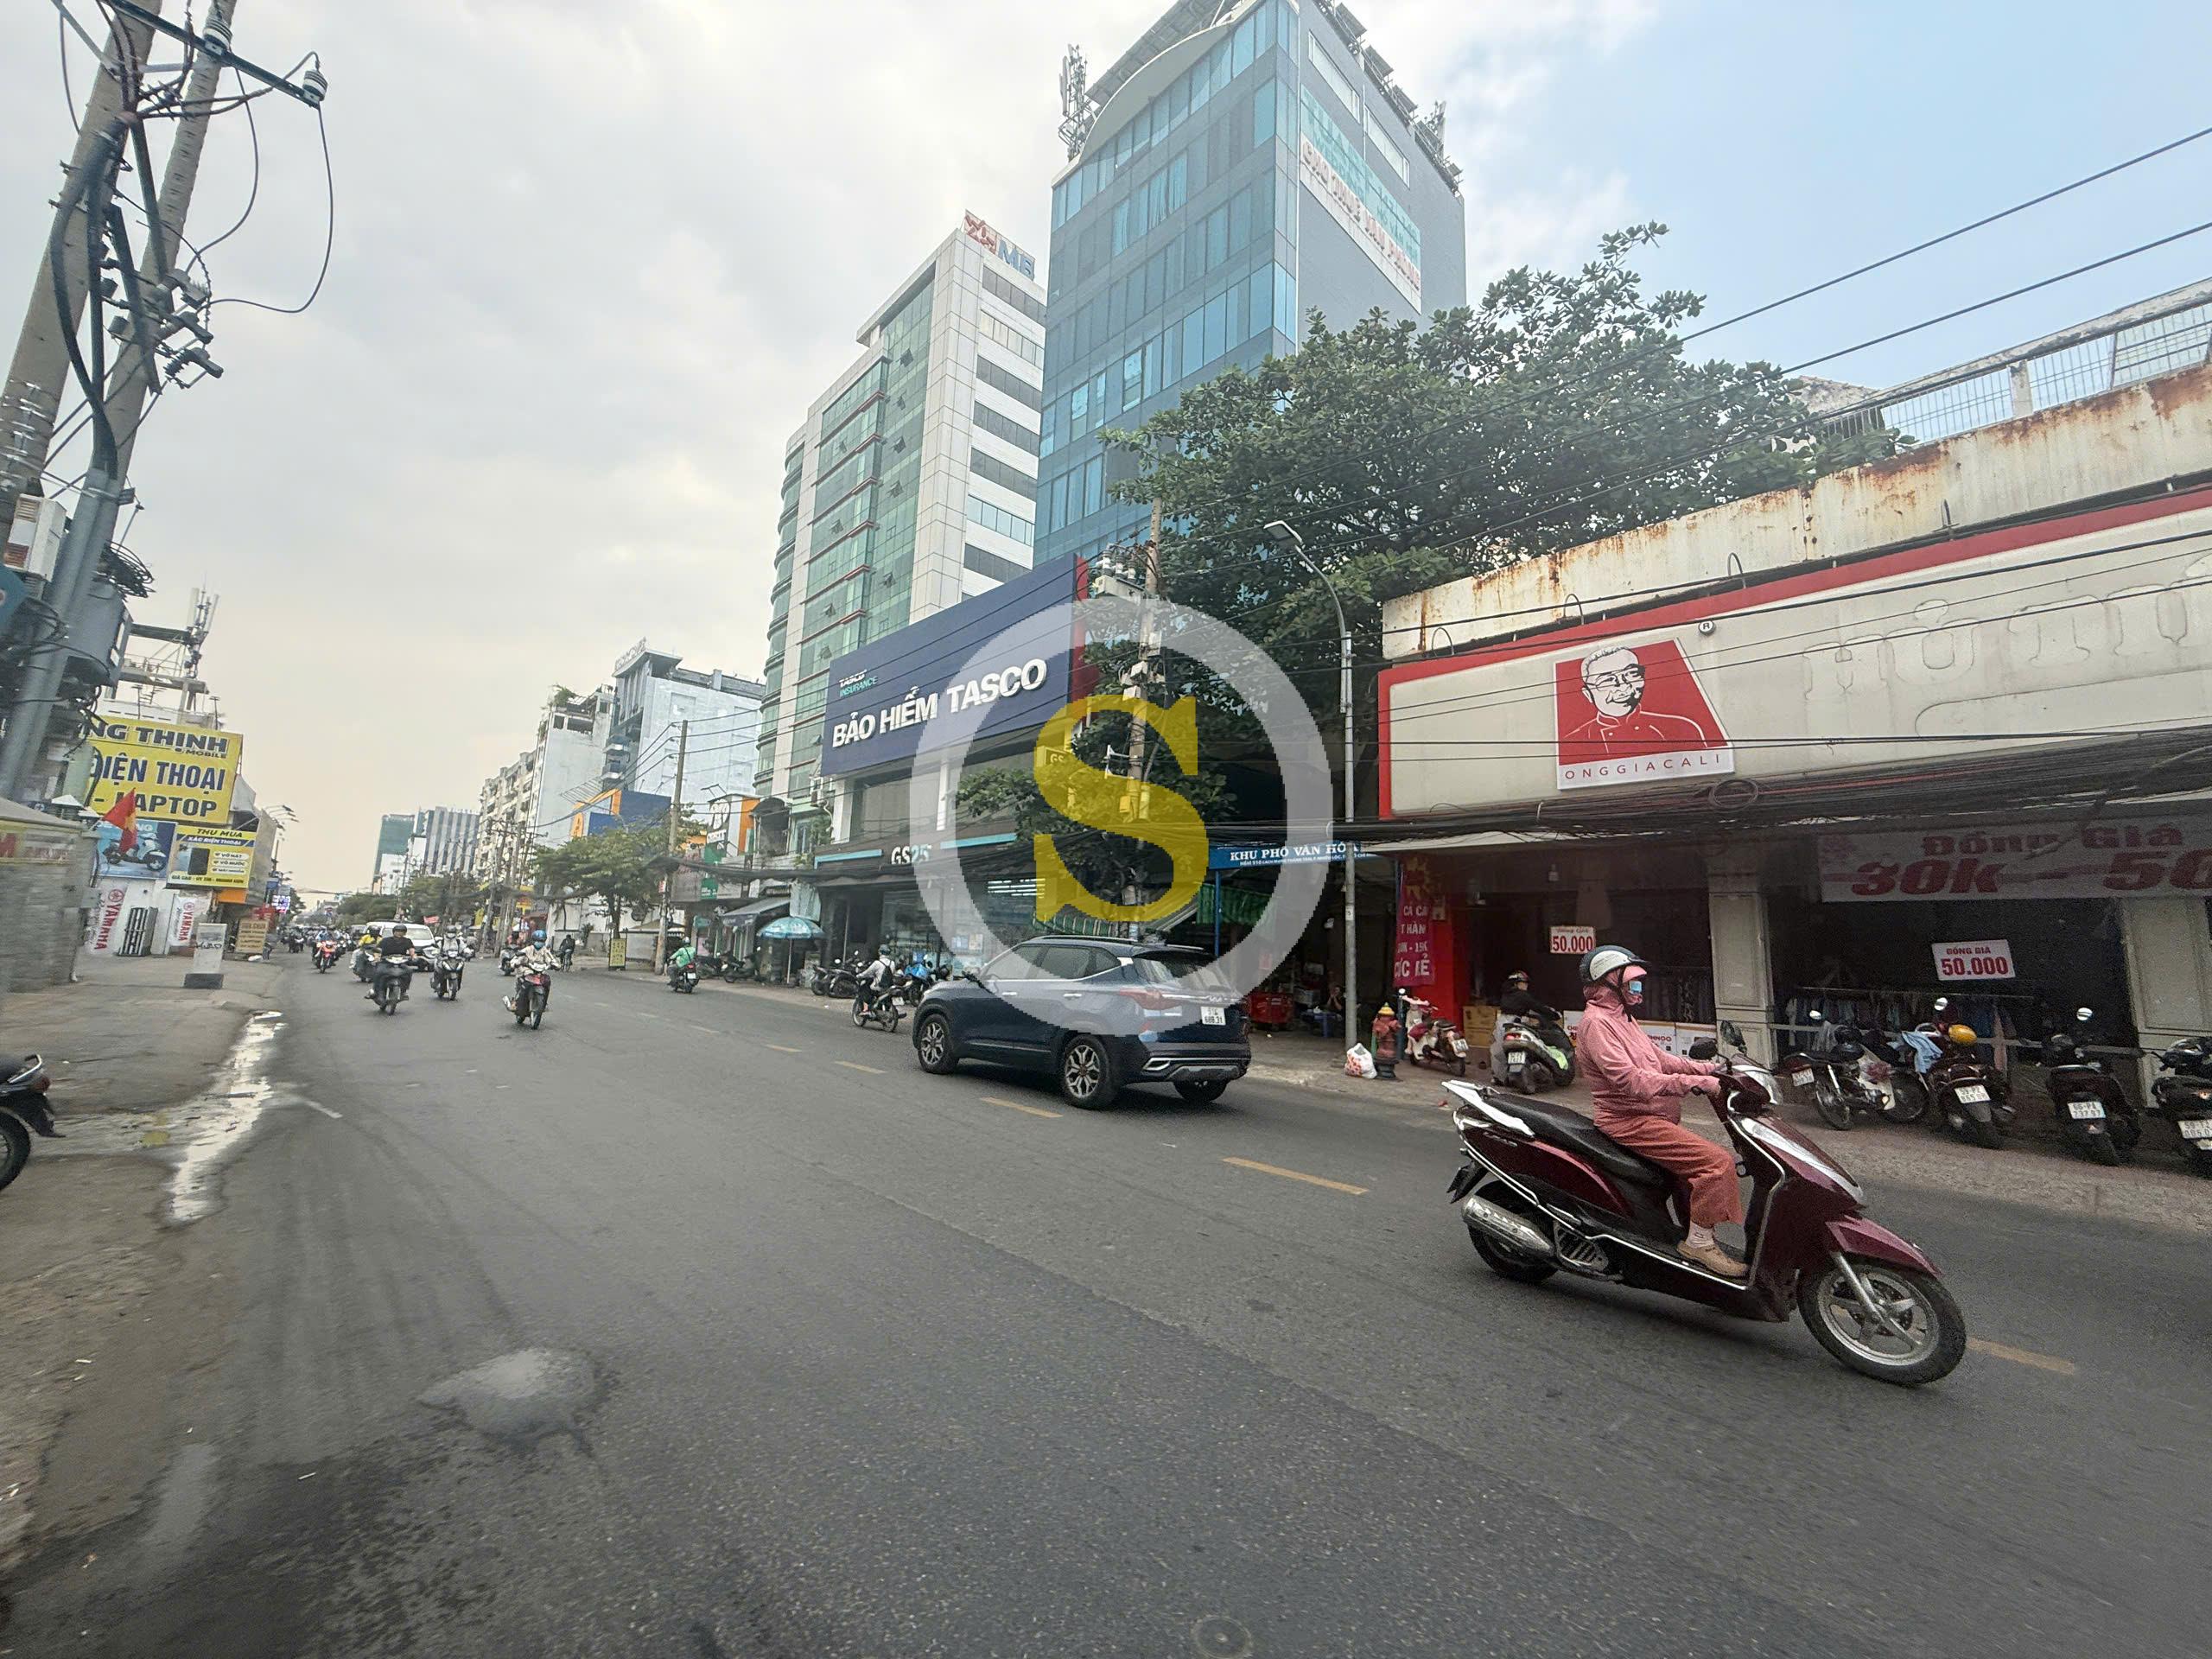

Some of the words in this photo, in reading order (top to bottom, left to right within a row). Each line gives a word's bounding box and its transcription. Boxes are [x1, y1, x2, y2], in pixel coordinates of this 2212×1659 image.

[832, 711, 875, 747] BẢO
[880, 685, 938, 734] HIỂM
[947, 658, 1047, 713] TASCO
[136, 728, 228, 753] THỊNH
[185, 749, 227, 759] MOBILE
[1565, 753, 1719, 779] ONGGIACALI
[156, 761, 226, 794] THOẠI
[891, 843, 931, 865] GS25
[1230, 850, 1258, 861] KHU
[94, 902, 122, 950] YAMAHA
[178, 911, 194, 941] YAMAHA
[1941, 956, 2009, 976] 50.000
